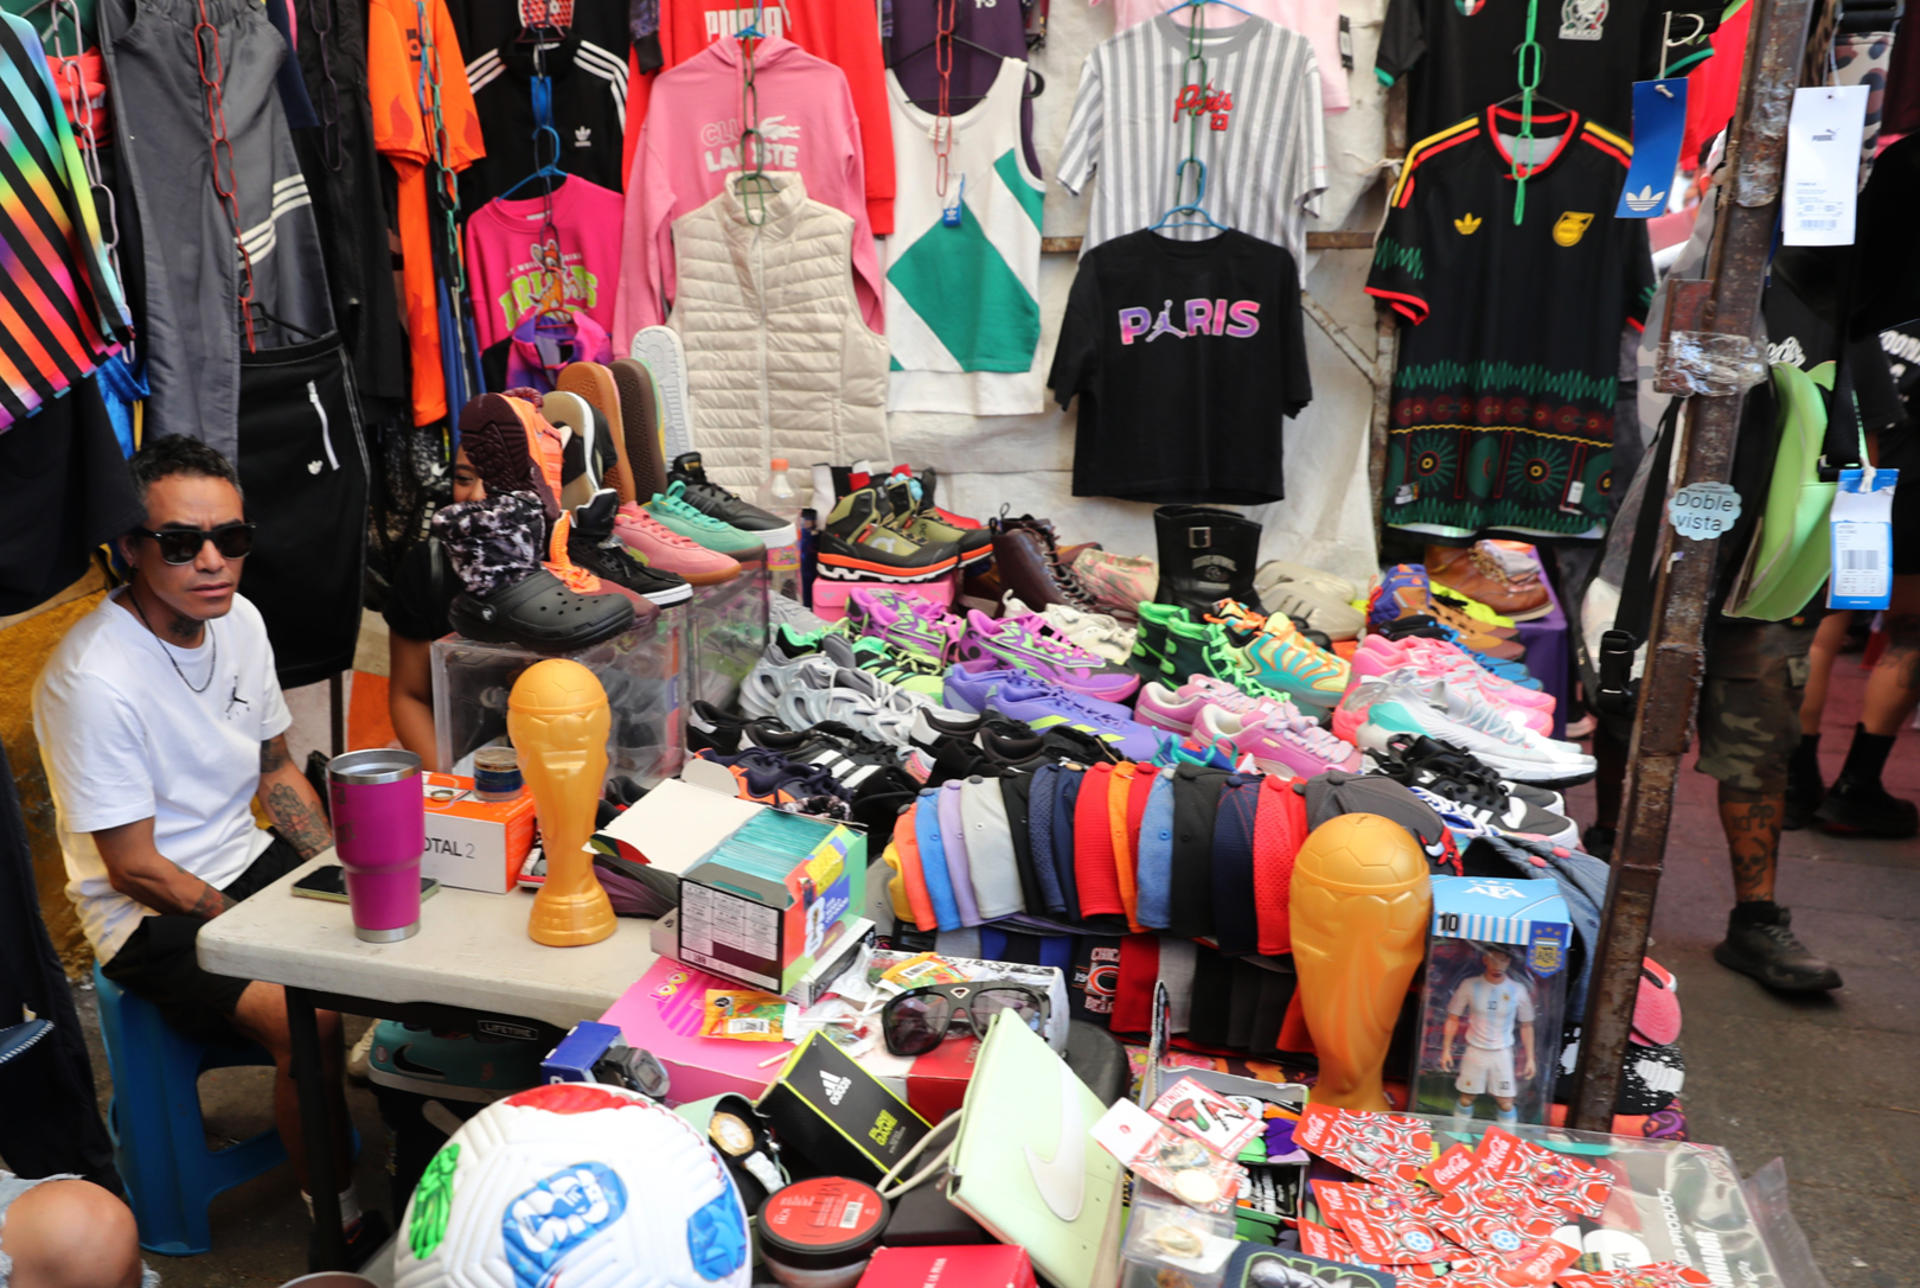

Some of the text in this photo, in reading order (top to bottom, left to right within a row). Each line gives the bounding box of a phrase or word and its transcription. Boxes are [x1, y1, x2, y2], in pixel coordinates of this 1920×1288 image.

[704, 7, 784, 42] PUMA
[1118, 298, 1260, 345] PARIS
[1675, 491, 1733, 512] Doble
[1676, 512, 1723, 532] vista
[424, 836, 476, 860] OTAL 2
[1438, 912, 1459, 933] 10
[1433, 1152, 1472, 1185] Coca-Cola
